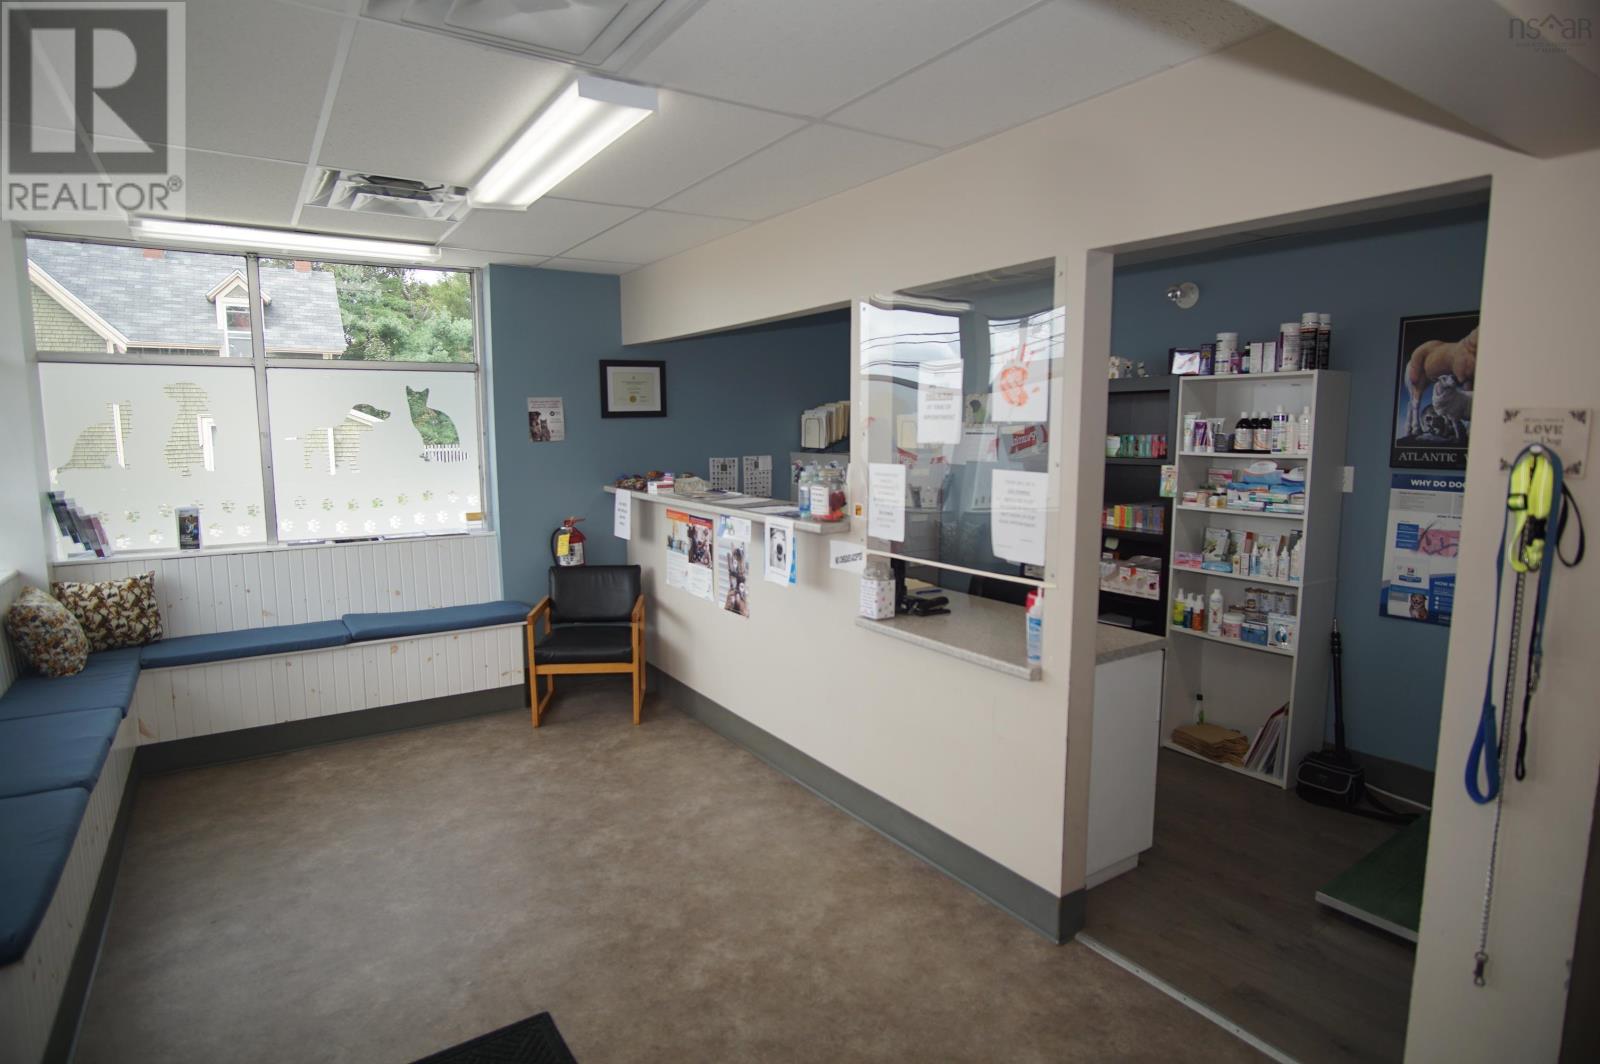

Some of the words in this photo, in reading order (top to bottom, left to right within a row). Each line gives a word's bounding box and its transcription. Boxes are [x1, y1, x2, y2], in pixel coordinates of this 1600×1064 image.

[1524, 424, 1564, 435] LOVE
[1398, 452, 1457, 462] ATLANTIC
[1411, 479, 1432, 487] WHY
[1433, 480, 1447, 488] DO
